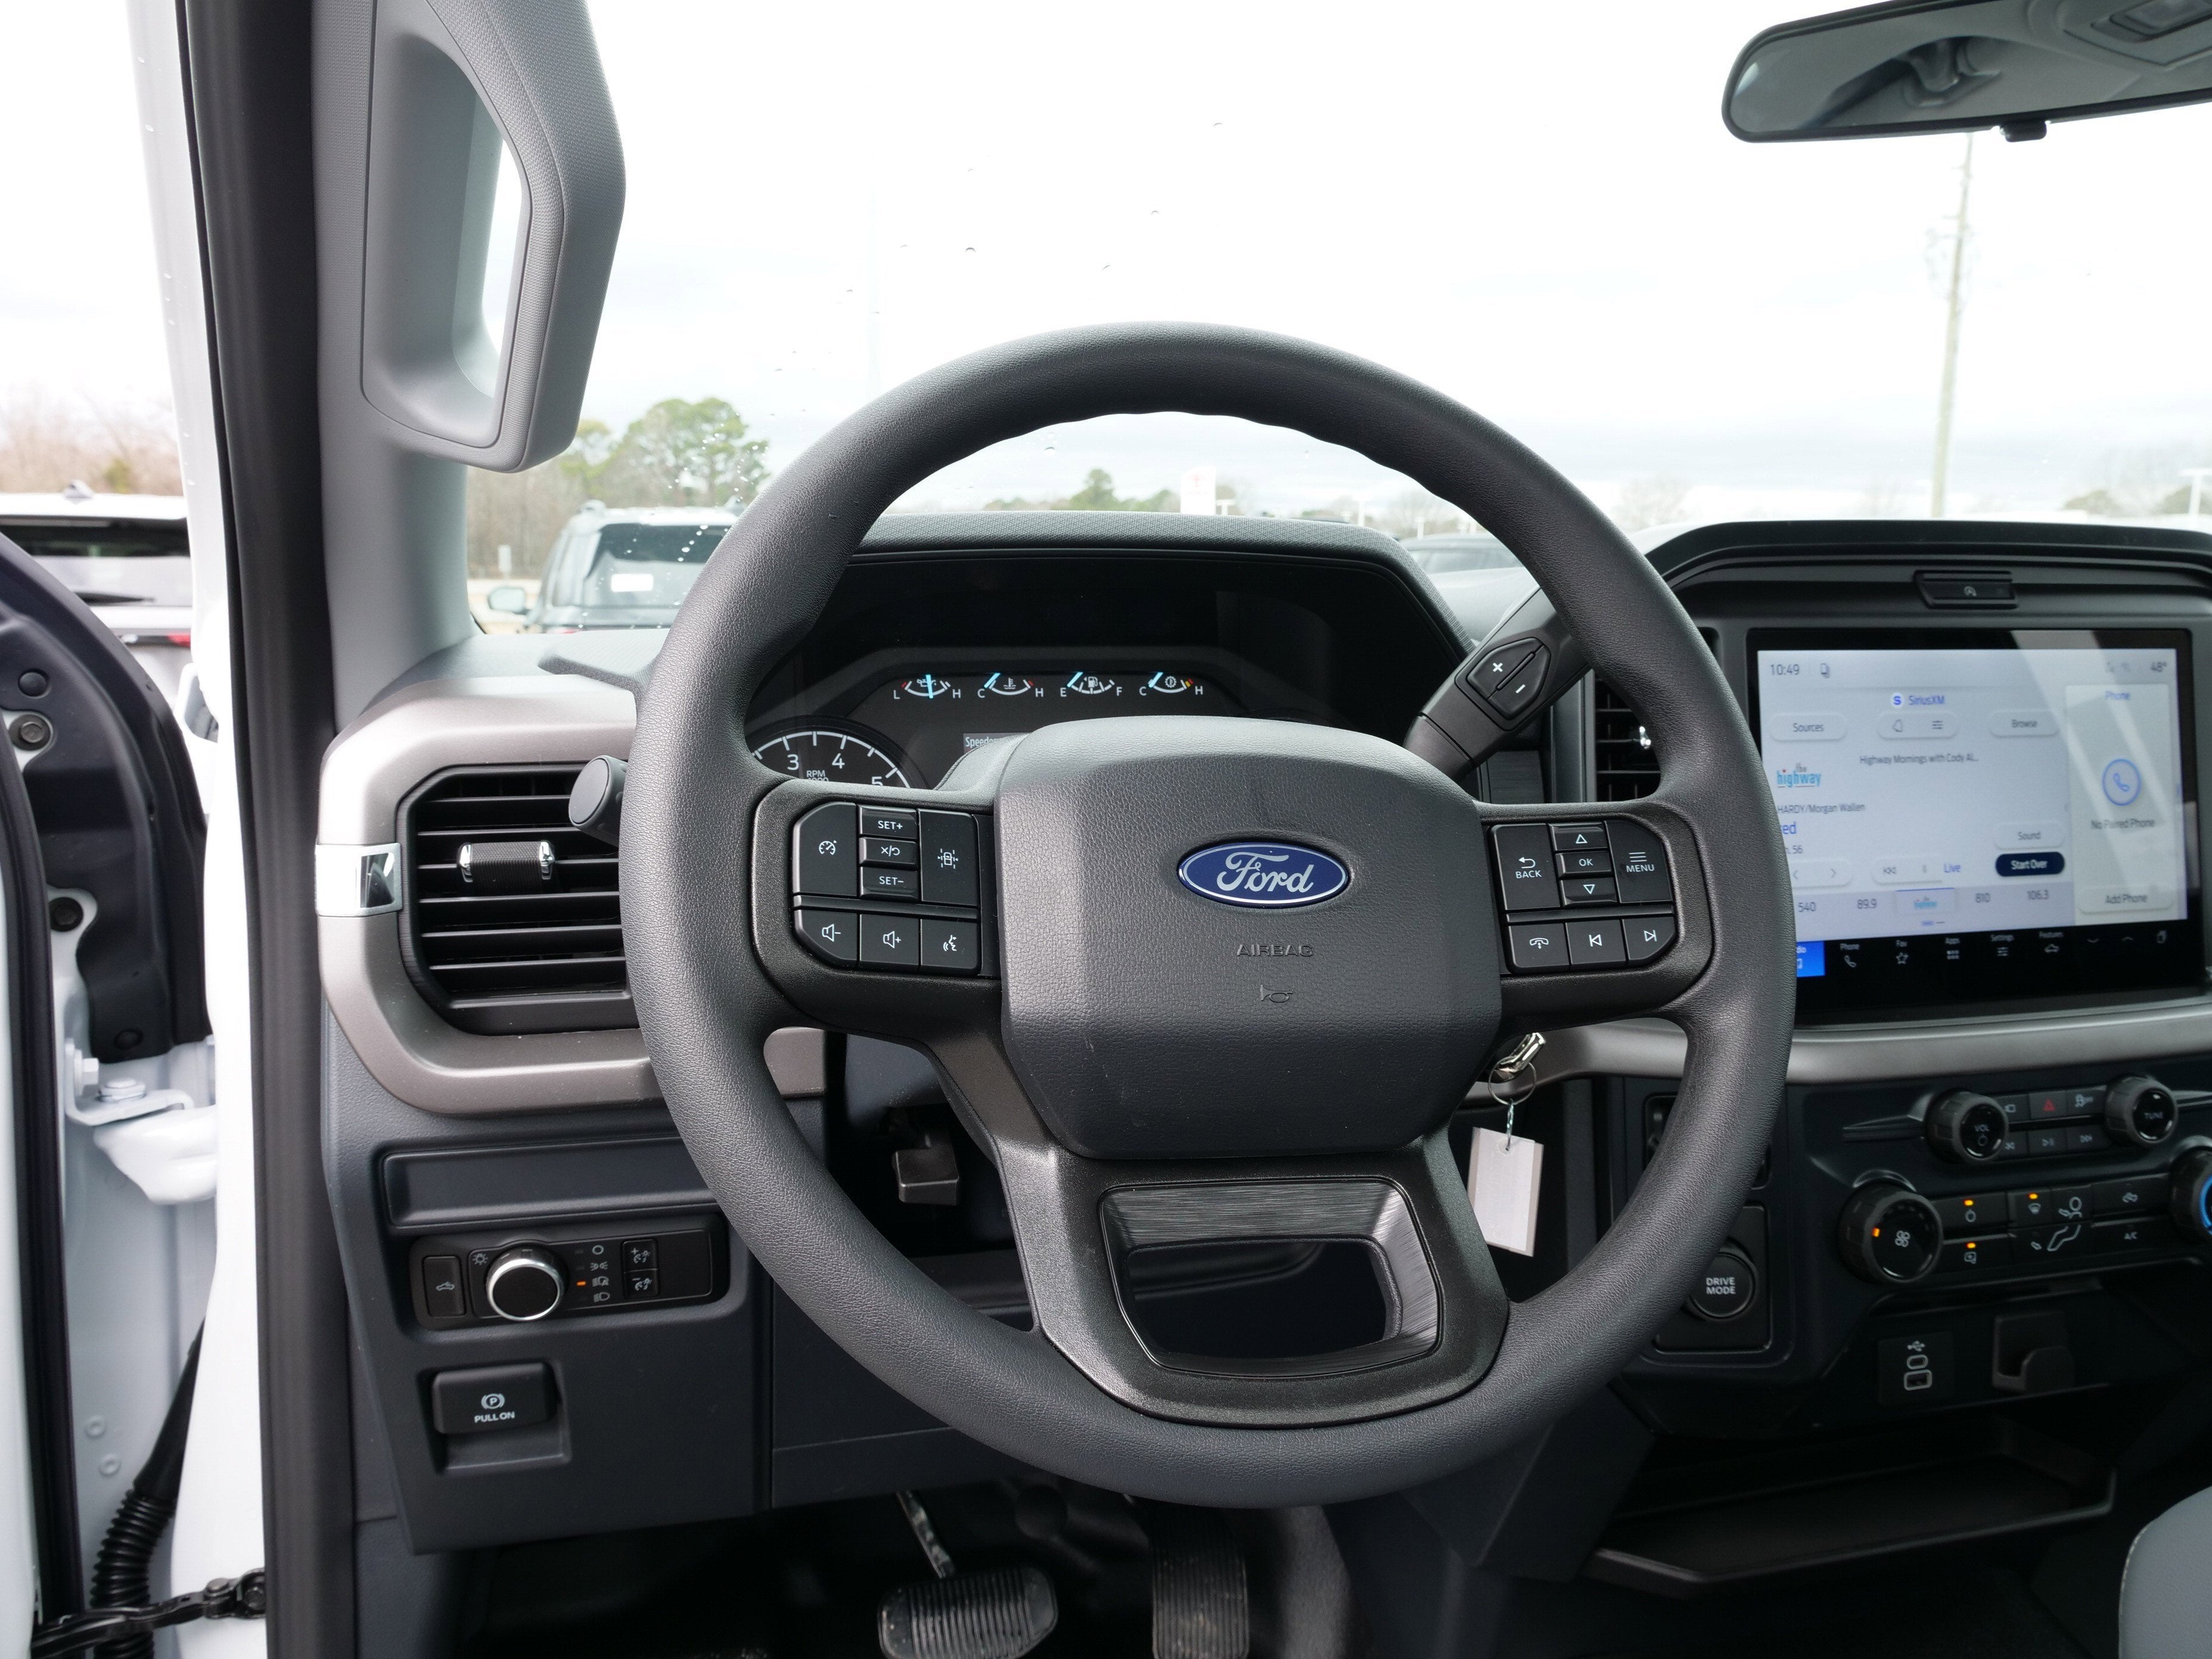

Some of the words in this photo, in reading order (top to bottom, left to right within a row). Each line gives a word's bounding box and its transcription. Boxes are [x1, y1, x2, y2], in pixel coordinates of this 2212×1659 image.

[1770, 664, 1800, 675] 10:49
[893, 689, 900, 700] L
[953, 689, 961, 698] H
[977, 689, 985, 698] C
[1035, 688, 1043, 697] H
[1060, 688, 1067, 697] E
[1116, 686, 1122, 696] F
[1139, 686, 1147, 696] C
[1195, 686, 1203, 695] H
[1793, 723, 1823, 732] Sources
[787, 754, 799, 771] 3
[832, 753, 845, 769] 4
[1860, 755, 1891, 766] Highway
[1929, 754, 1945, 762] with
[871, 776, 882, 786] 5
[1776, 769, 1821, 788] highway
[1792, 844, 1803, 854] 56
[1579, 858, 1593, 866] OK
[2011, 859, 2029, 870] Start
[1217, 851, 1314, 893] Ford
[1626, 863, 1655, 873] MENU
[1944, 863, 1961, 873] Live
[1515, 869, 1542, 879] BACK
[1798, 902, 1816, 912] 540
[1857, 899, 1877, 909] 89.9
[1237, 944, 1313, 957] AIRBAG
[1705, 1277, 1735, 1286] DRIVE
[1705, 1285, 1736, 1295] MODE
[474, 1414, 499, 1423] PULL
[499, 1411, 515, 1420] ON
